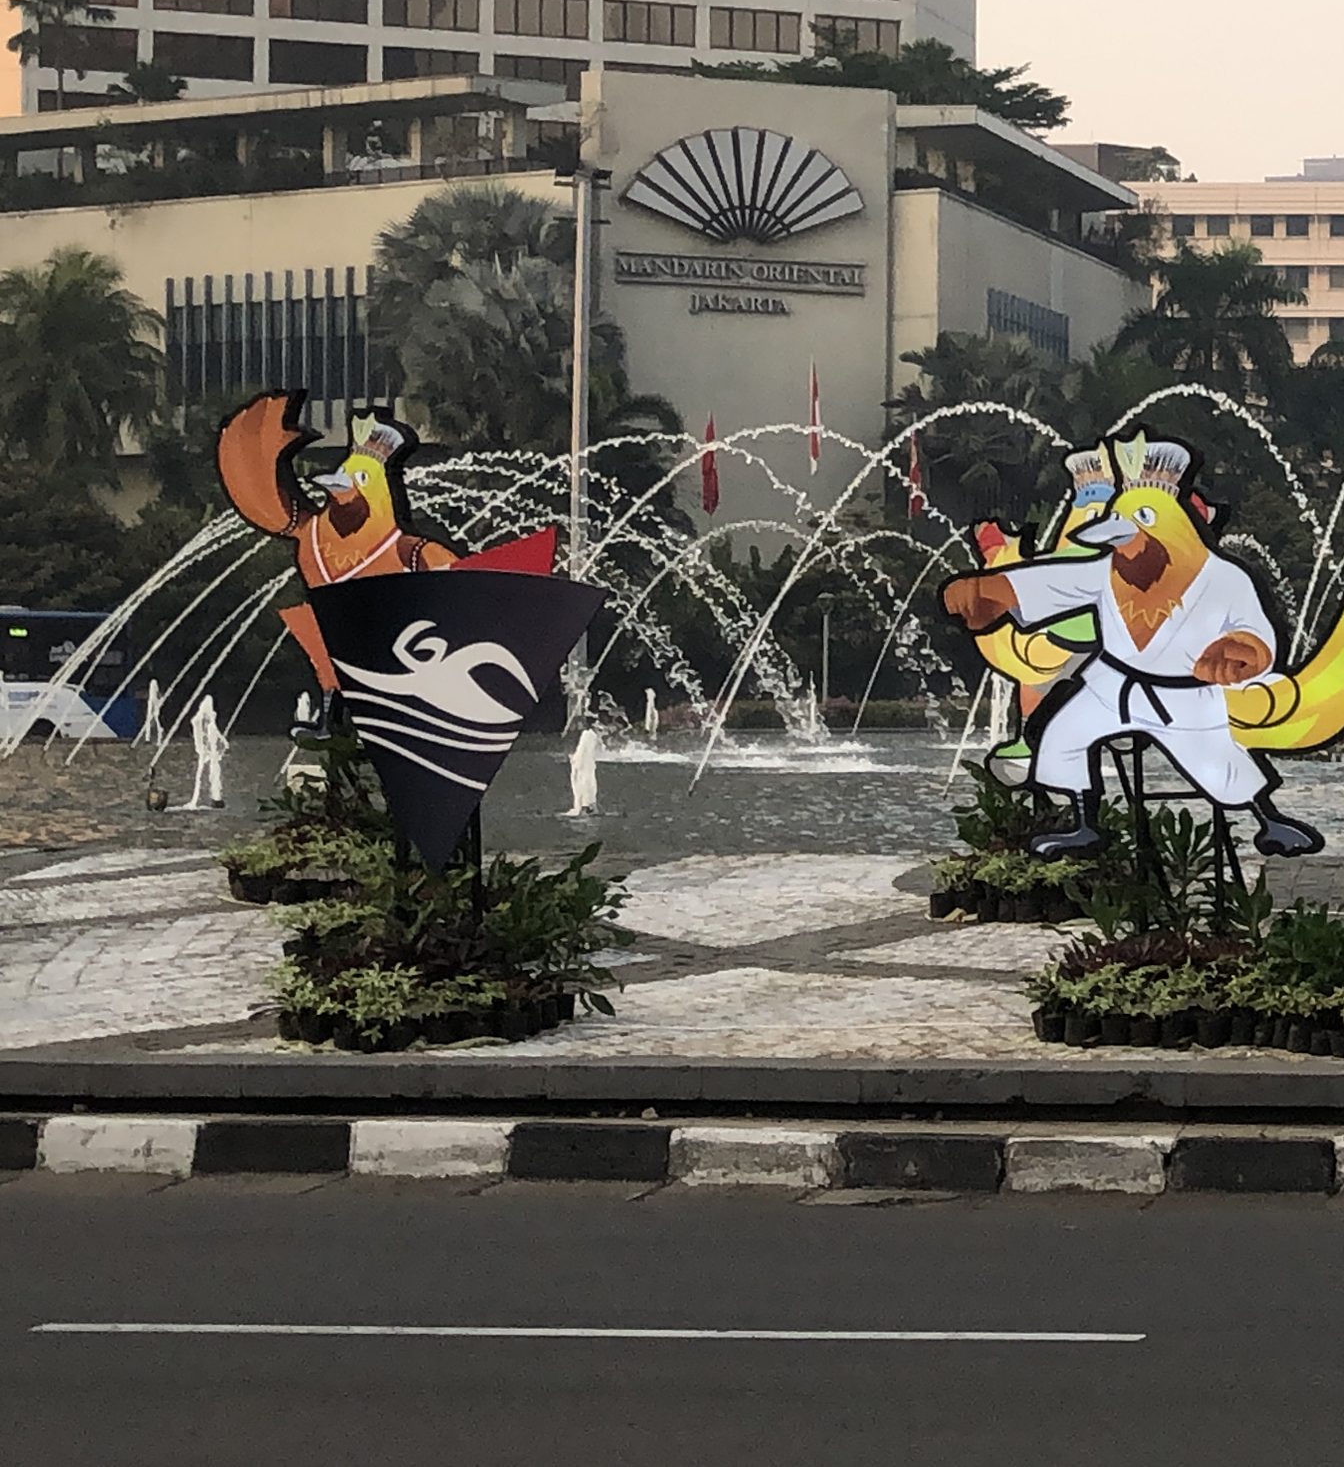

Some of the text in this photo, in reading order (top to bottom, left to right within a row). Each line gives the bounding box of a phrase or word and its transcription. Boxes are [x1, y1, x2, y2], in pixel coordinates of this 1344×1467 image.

[616, 257, 861, 284] MANDARIN ORIENTAL
[689, 293, 790, 315] JAKARTA
